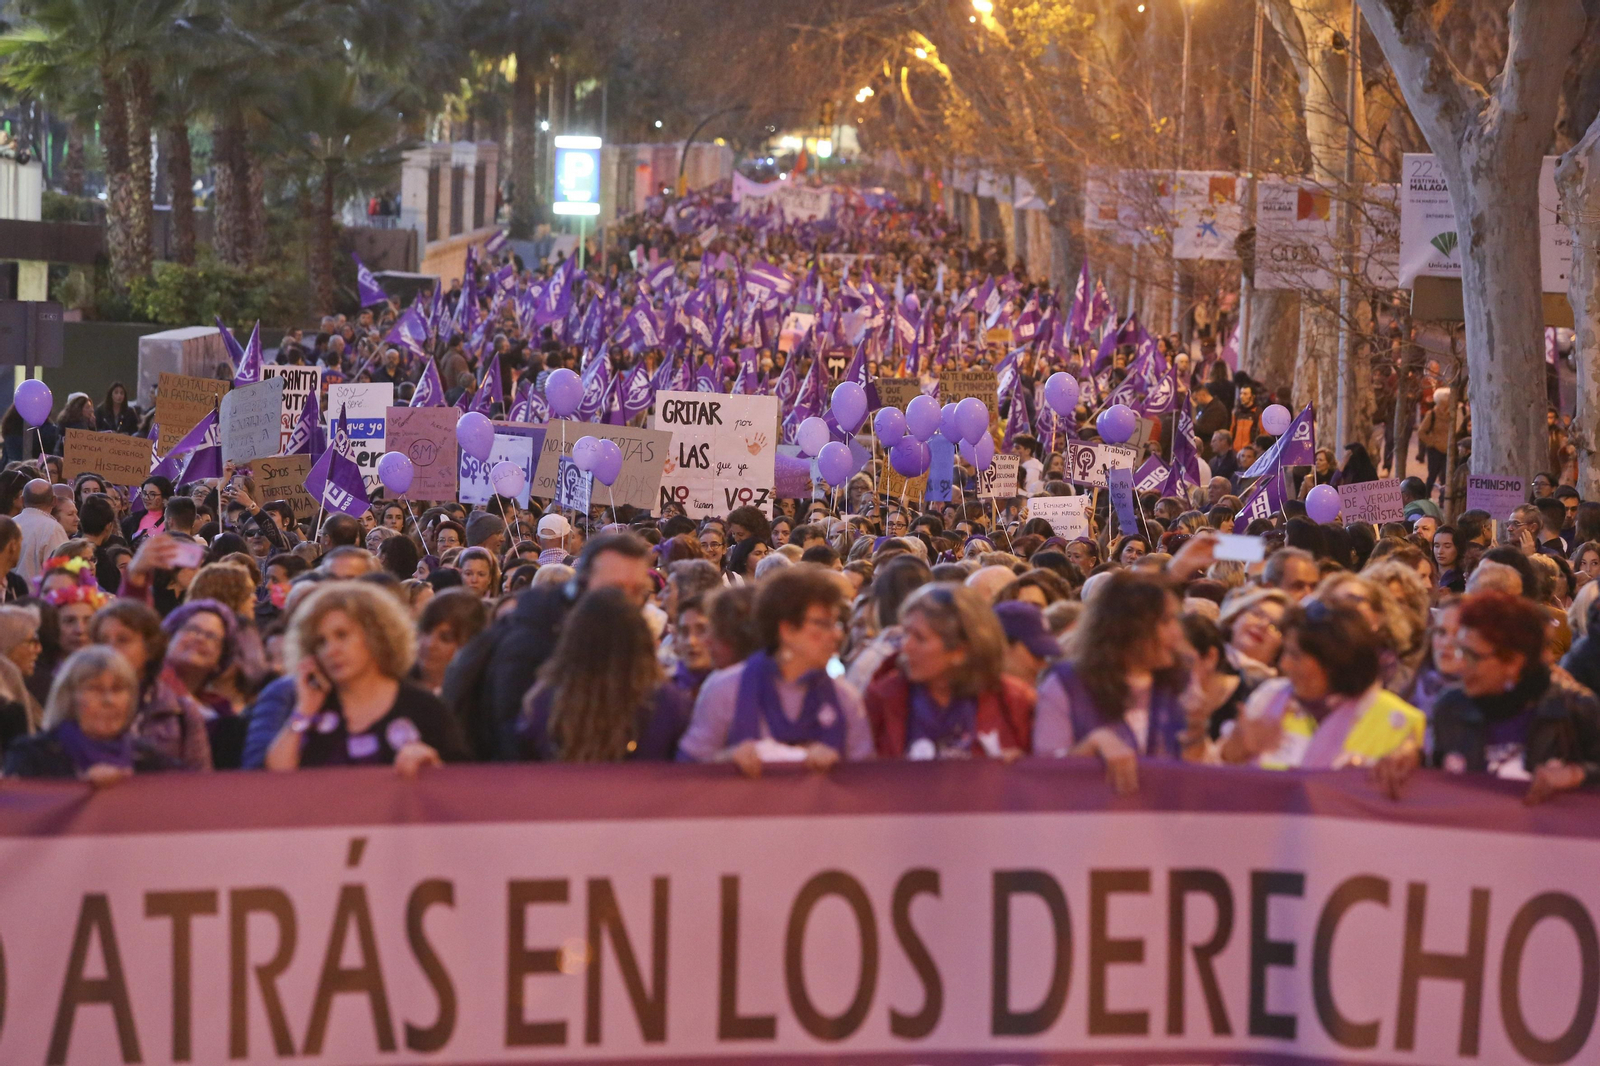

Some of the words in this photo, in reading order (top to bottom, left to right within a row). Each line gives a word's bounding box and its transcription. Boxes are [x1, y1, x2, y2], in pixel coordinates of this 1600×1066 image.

[565, 152, 594, 188] P
[1411, 160, 1432, 177] 22
[1428, 262, 1451, 270] Unicaja
[160, 374, 170, 386] NI
[280, 370, 318, 391] SANTA
[941, 382, 949, 391] EL
[954, 382, 997, 391] FEMINISMO
[160, 388, 168, 398] NI
[662, 400, 723, 426] GRITAR
[734, 420, 753, 431] por
[69, 431, 84, 439] NO
[346, 422, 364, 436] que
[366, 423, 382, 436] yo
[70, 444, 102, 453] NOTICIA
[109, 448, 144, 459] QUEREMOS
[411, 444, 432, 460] 8M
[544, 439, 558, 452] NO
[1104, 446, 1131, 456] Trabajo
[680, 442, 710, 470] LAS
[716, 462, 732, 476] que
[738, 463, 748, 476] ya
[72, 458, 86, 466] SER
[95, 458, 147, 478] HISTORIA!
[259, 484, 293, 498] FUERTES
[1342, 485, 1358, 494] LOS
[1362, 480, 1400, 492] HOMBRES
[1470, 478, 1521, 491] FEMINISMO
[724, 488, 770, 514] VOZ
[1344, 496, 1358, 508] DE
[1364, 492, 1401, 505] VERDAD
[1346, 508, 1404, 523] FEMINISTAS
[1360, 504, 1380, 514] SON
[45, 837, 458, 1066] ATRÁS
[505, 875, 671, 1047] EN
[717, 867, 945, 1043] LOS
[990, 868, 1600, 1066] DERECHO
